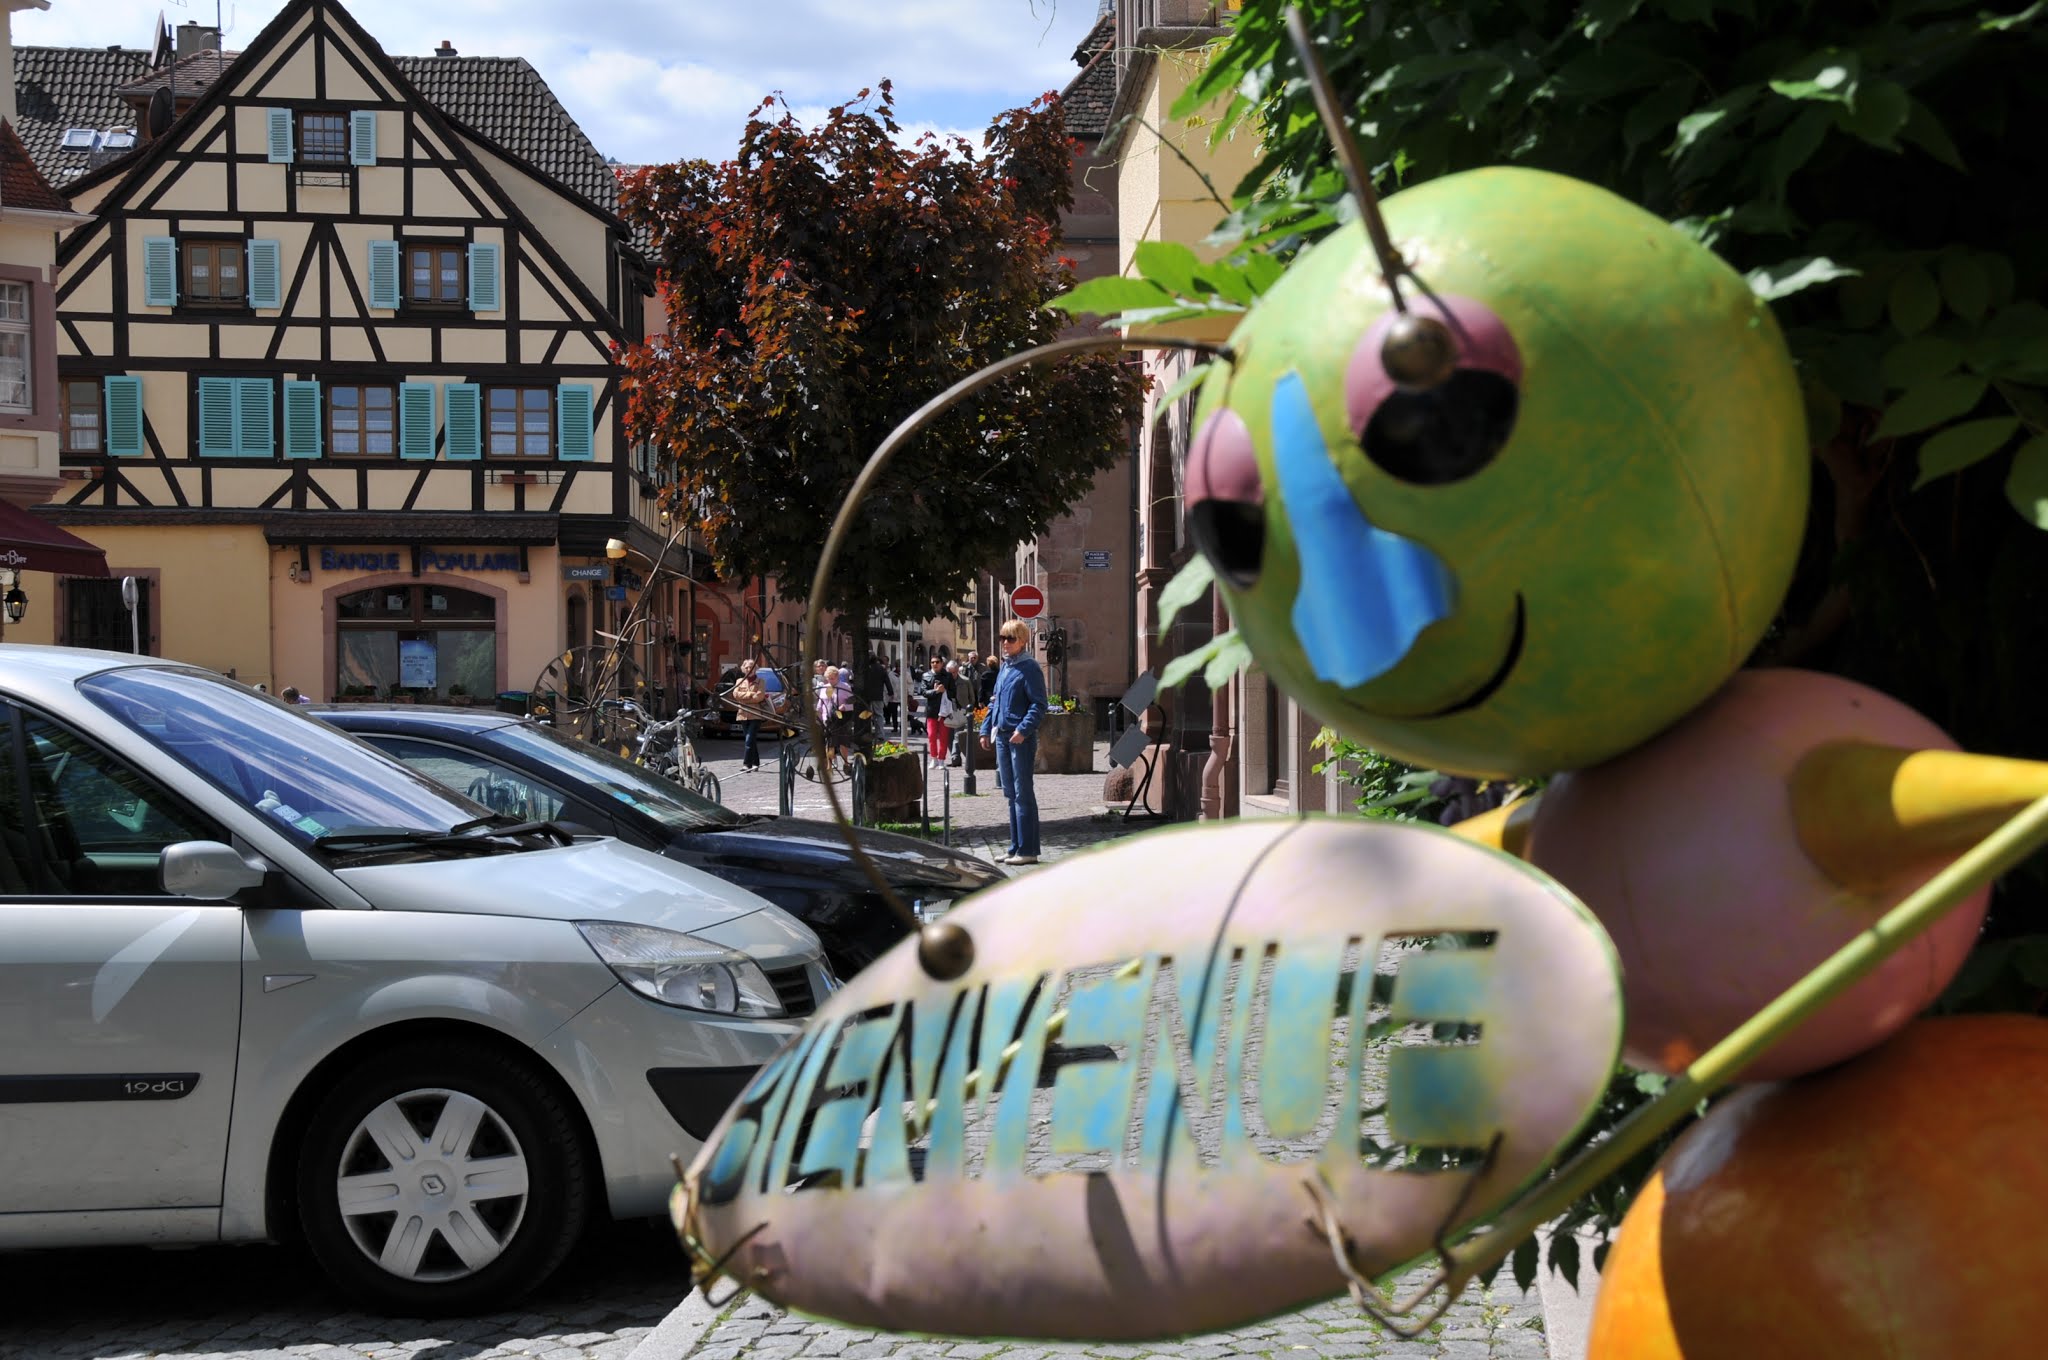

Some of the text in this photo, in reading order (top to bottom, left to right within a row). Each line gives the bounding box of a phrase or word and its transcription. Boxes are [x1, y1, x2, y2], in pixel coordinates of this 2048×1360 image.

[320, 547, 400, 570] BANQUE
[571, 569, 602, 577] CHANGE
[701, 930, 1500, 1205] BIENVENUE
[125, 1081, 184, 1094] 1.9 dCi
